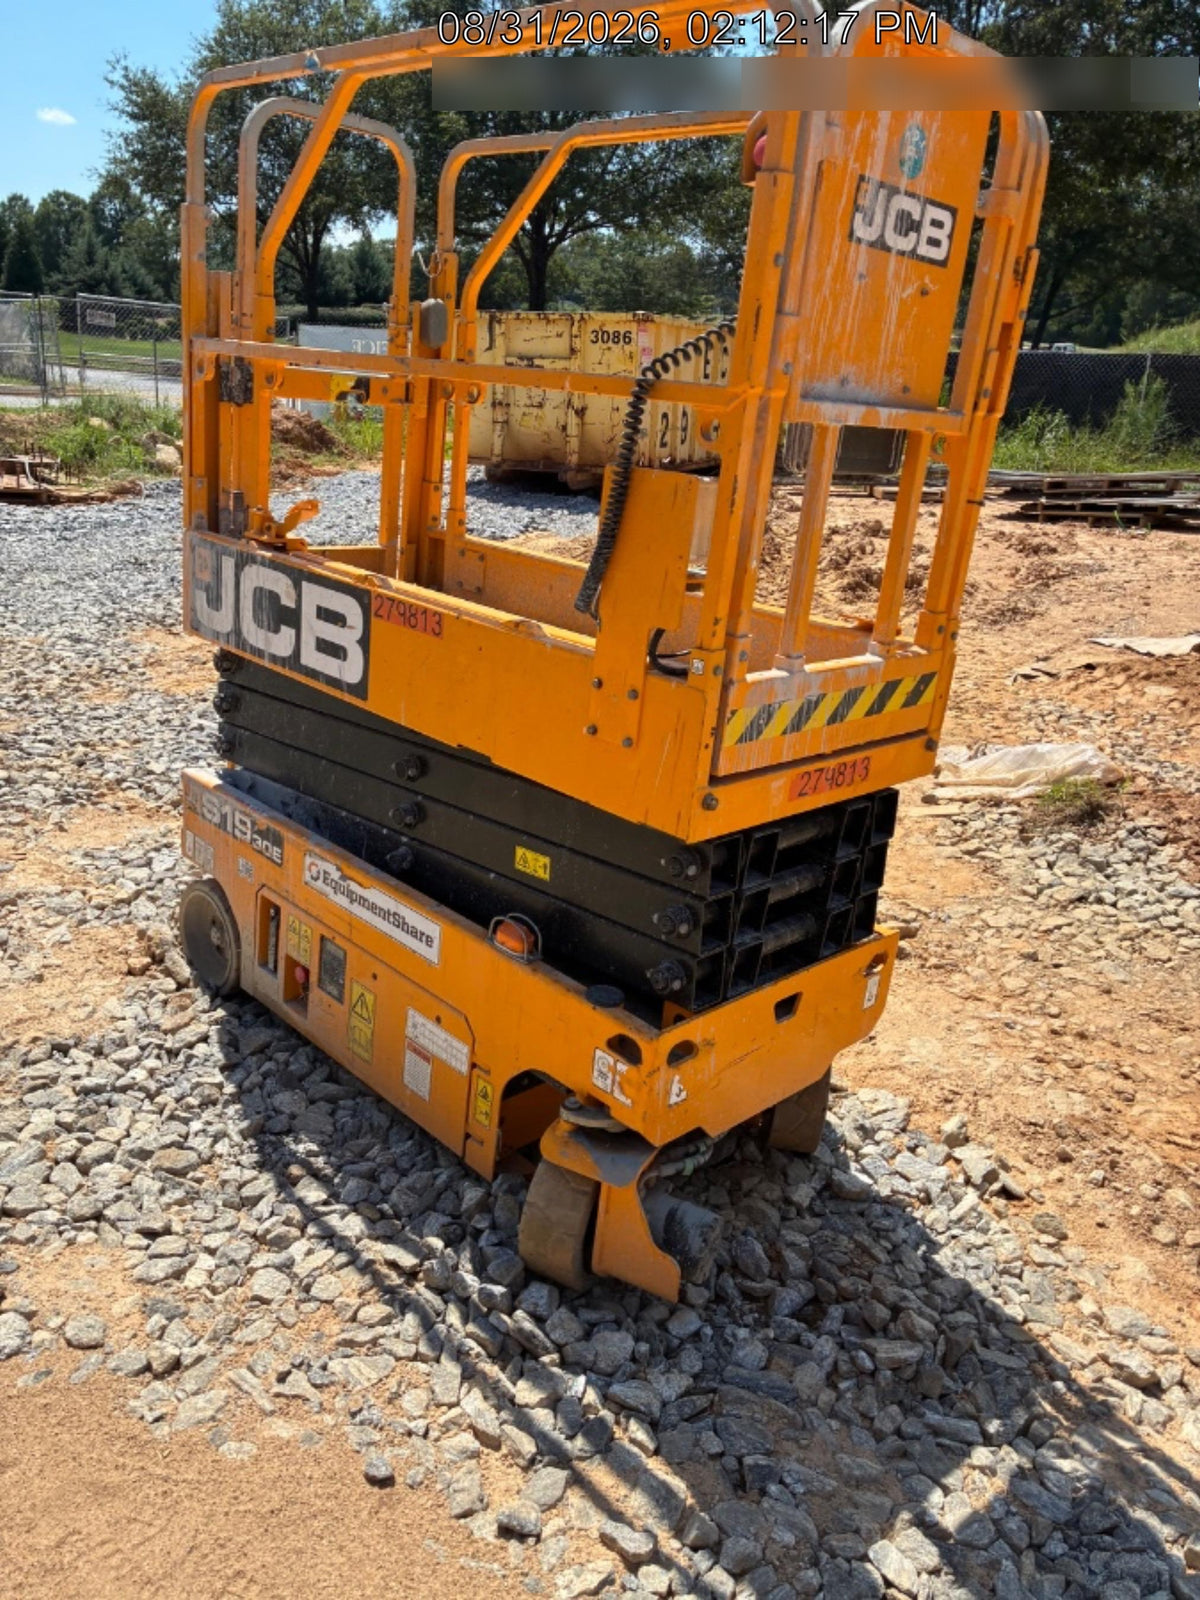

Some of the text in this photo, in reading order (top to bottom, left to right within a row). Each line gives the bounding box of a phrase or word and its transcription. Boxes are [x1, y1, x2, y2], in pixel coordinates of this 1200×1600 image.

[853, 188, 954, 261] JCB
[590, 330, 632, 345] 3086
[195, 555, 363, 684] JCB
[321, 869, 434, 949] EquipmentShare
